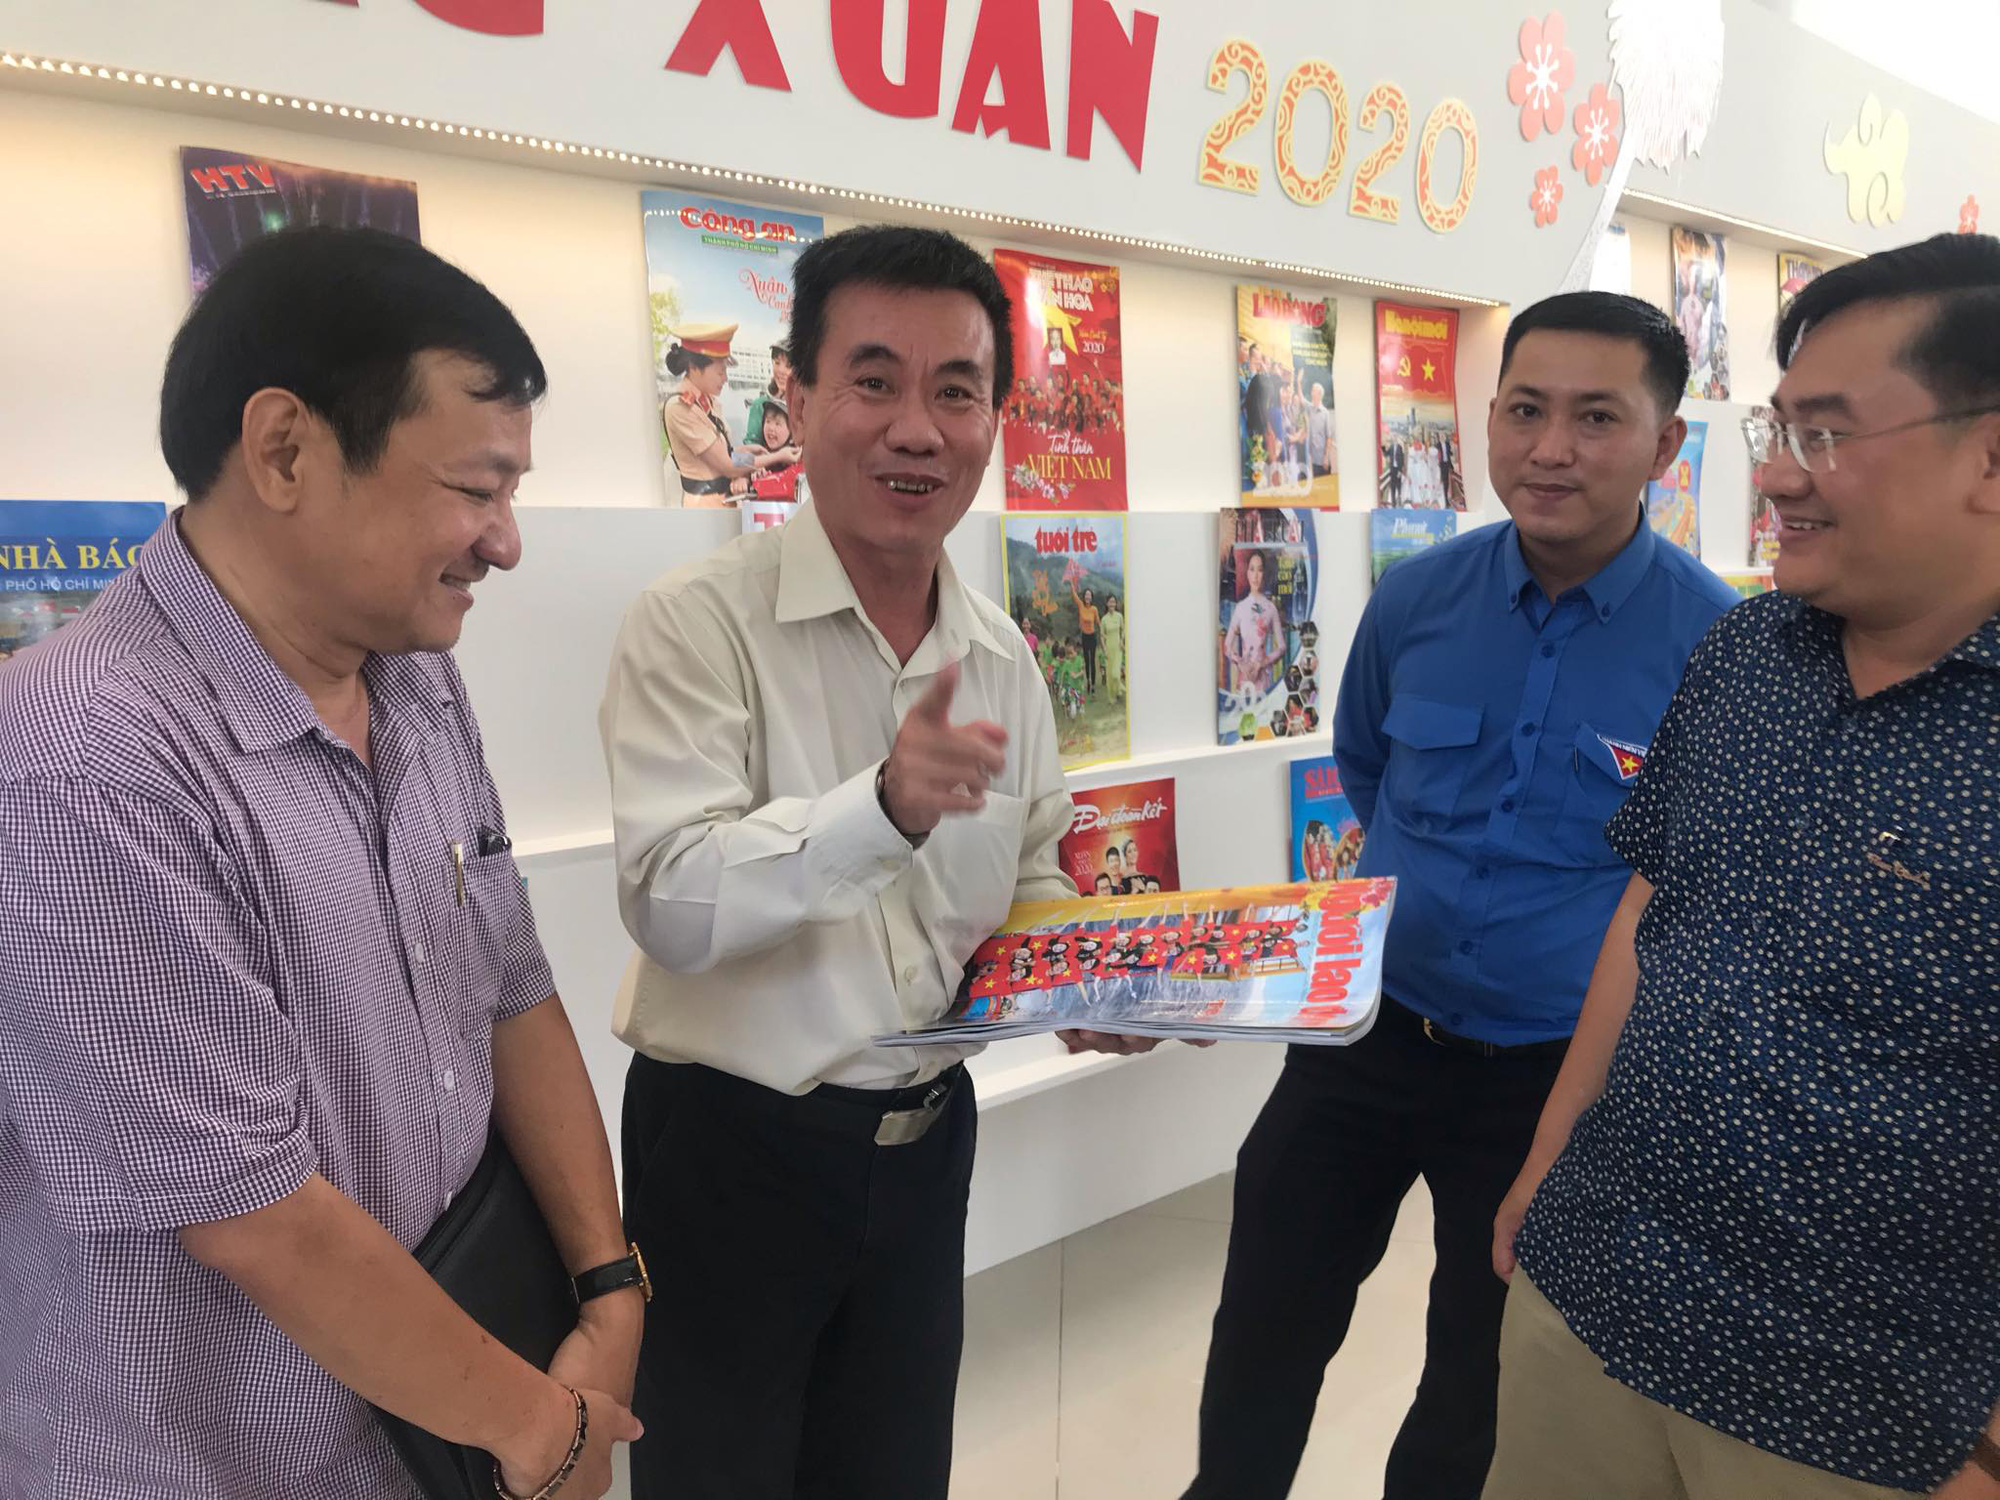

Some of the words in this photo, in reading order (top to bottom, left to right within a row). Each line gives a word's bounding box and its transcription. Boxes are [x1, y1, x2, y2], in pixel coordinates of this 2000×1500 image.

[1197, 38, 1479, 234] 2020
[190, 163, 275, 193] HTV
[681, 207, 755, 241] Công
[760, 221, 797, 244] an
[739, 268, 787, 303] Xuân
[1055, 272, 1094, 293] THAO
[1082, 341, 1105, 354] 2020
[1028, 453, 1069, 483] VIỆT
[1070, 455, 1111, 480] NAM
[5, 576, 37, 591] PHỐ
[65, 576, 89, 590] CHÍ
[93, 578, 115, 590] MI
[1306, 958, 1361, 1003] lao
